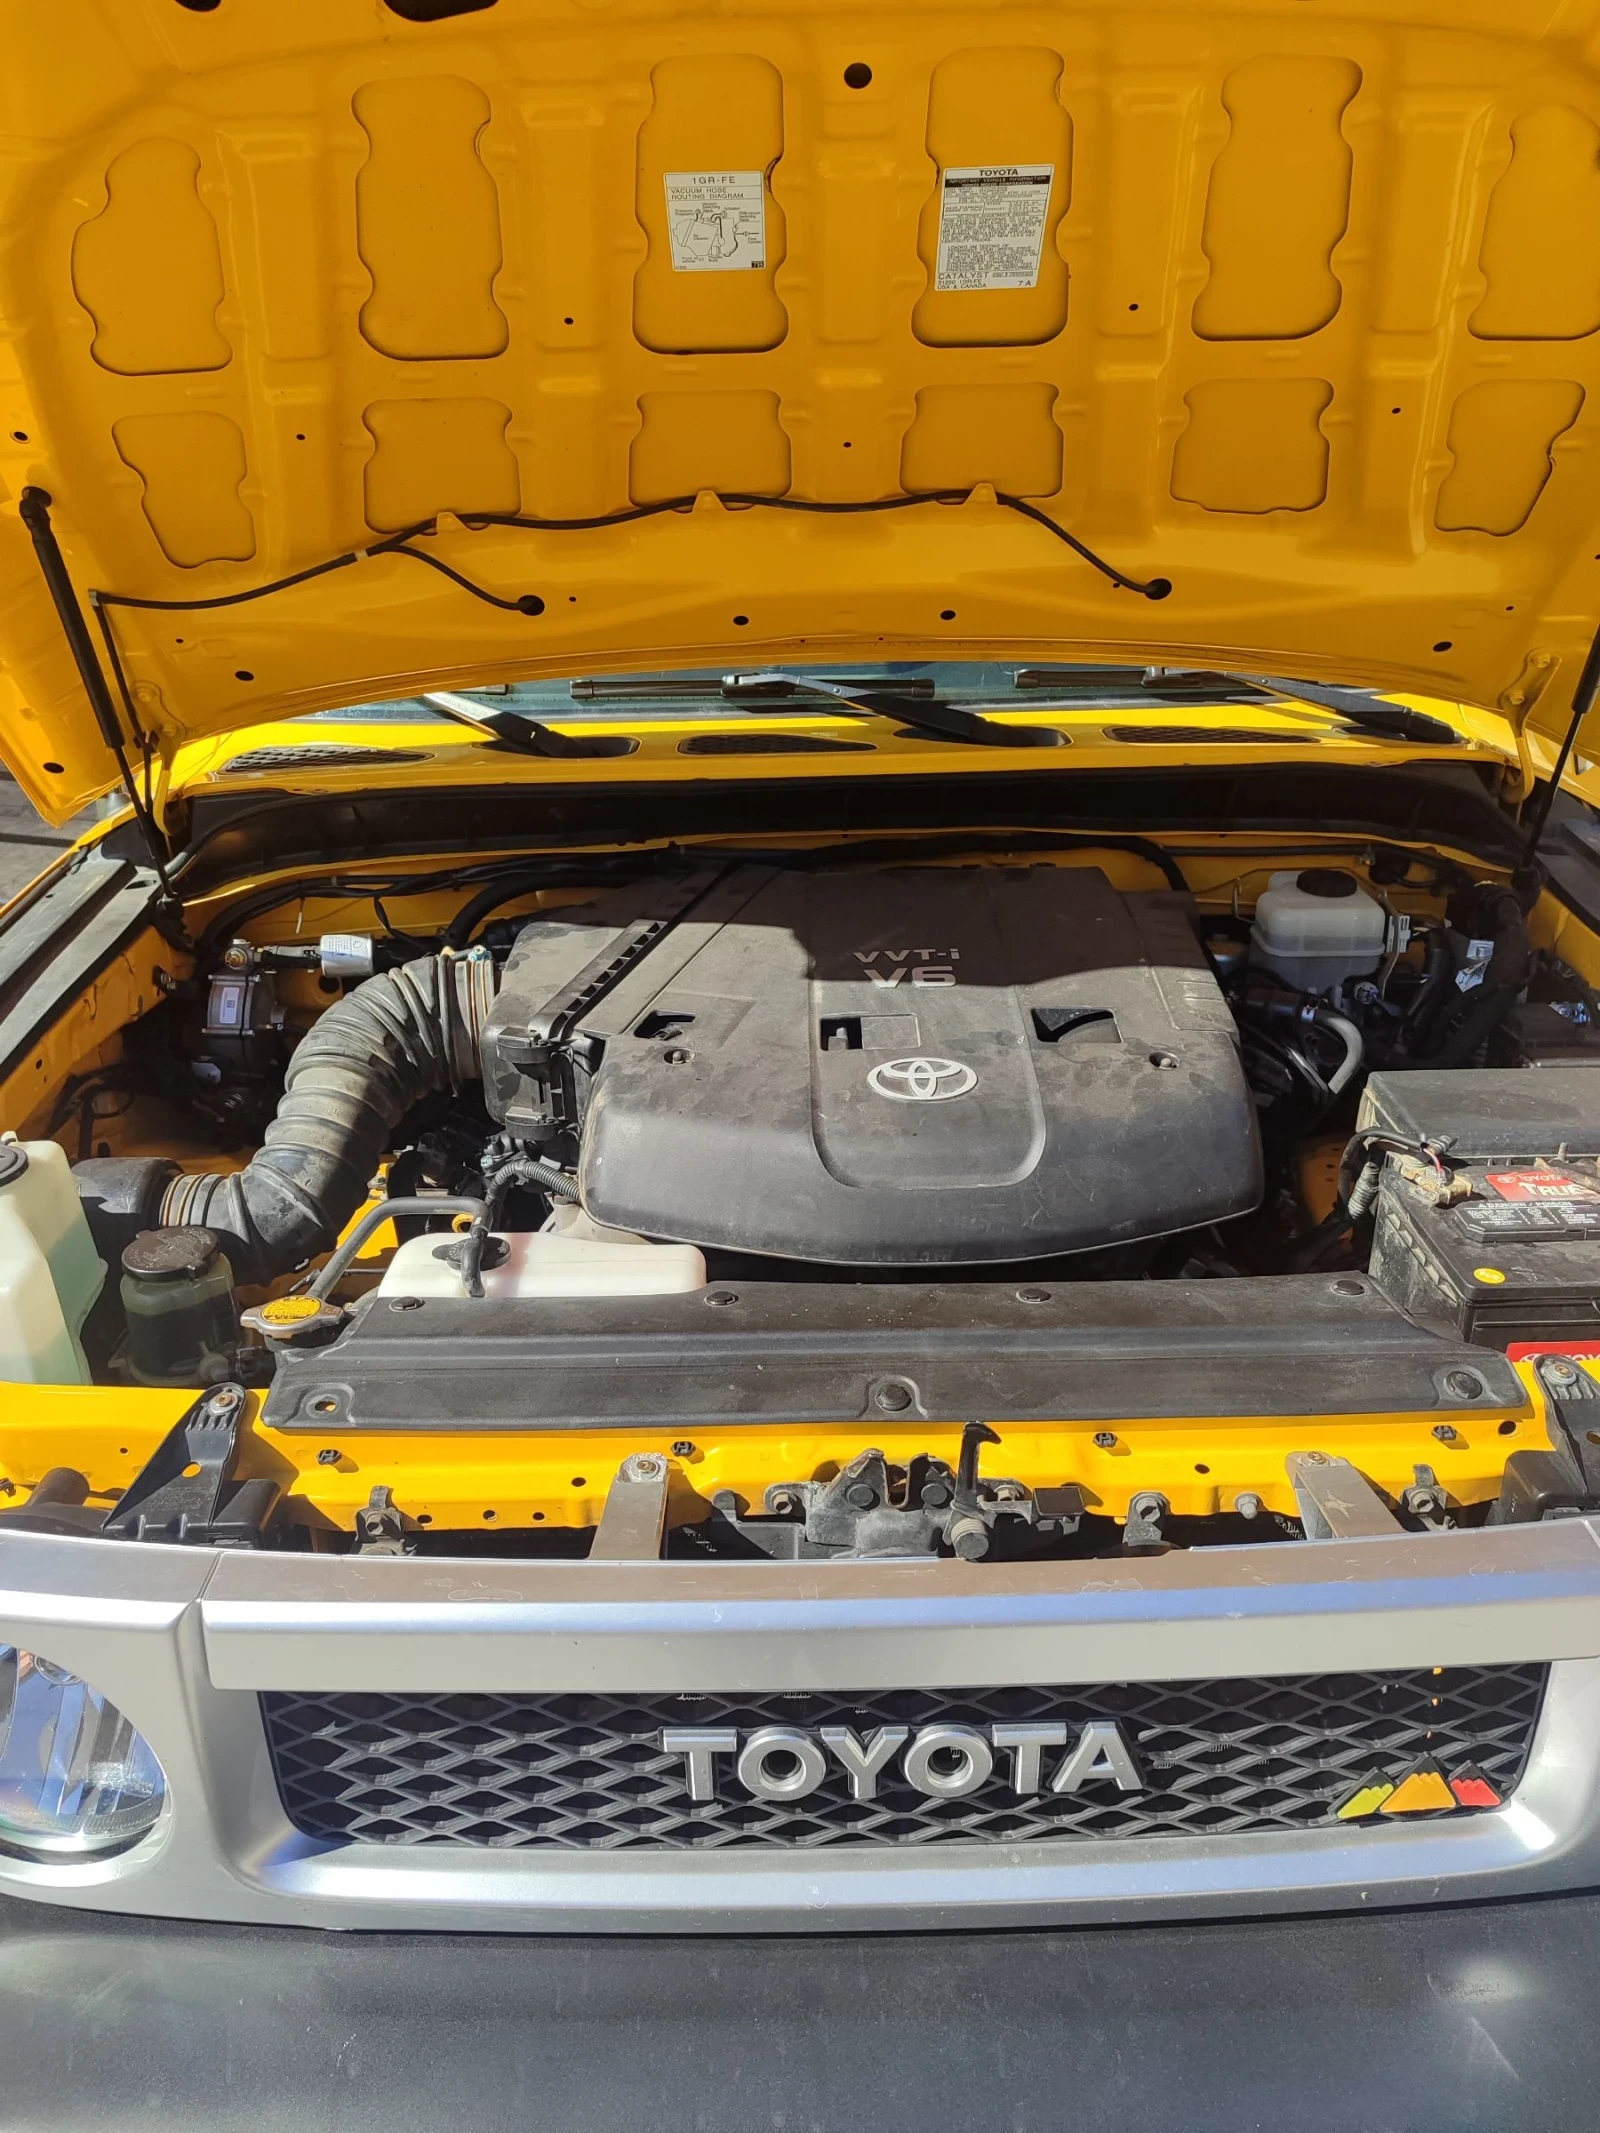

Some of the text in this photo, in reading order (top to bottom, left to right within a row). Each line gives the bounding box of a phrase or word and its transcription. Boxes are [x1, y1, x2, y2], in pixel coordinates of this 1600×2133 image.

[979, 168, 1018, 176] TOYOTA
[693, 176, 736, 184] 1GR-FE
[938, 271, 989, 280] CATALYST
[853, 948, 960, 963] VVT-i
[863, 965, 956, 988] V6
[663, 1721, 1143, 1801] TOYOTA
